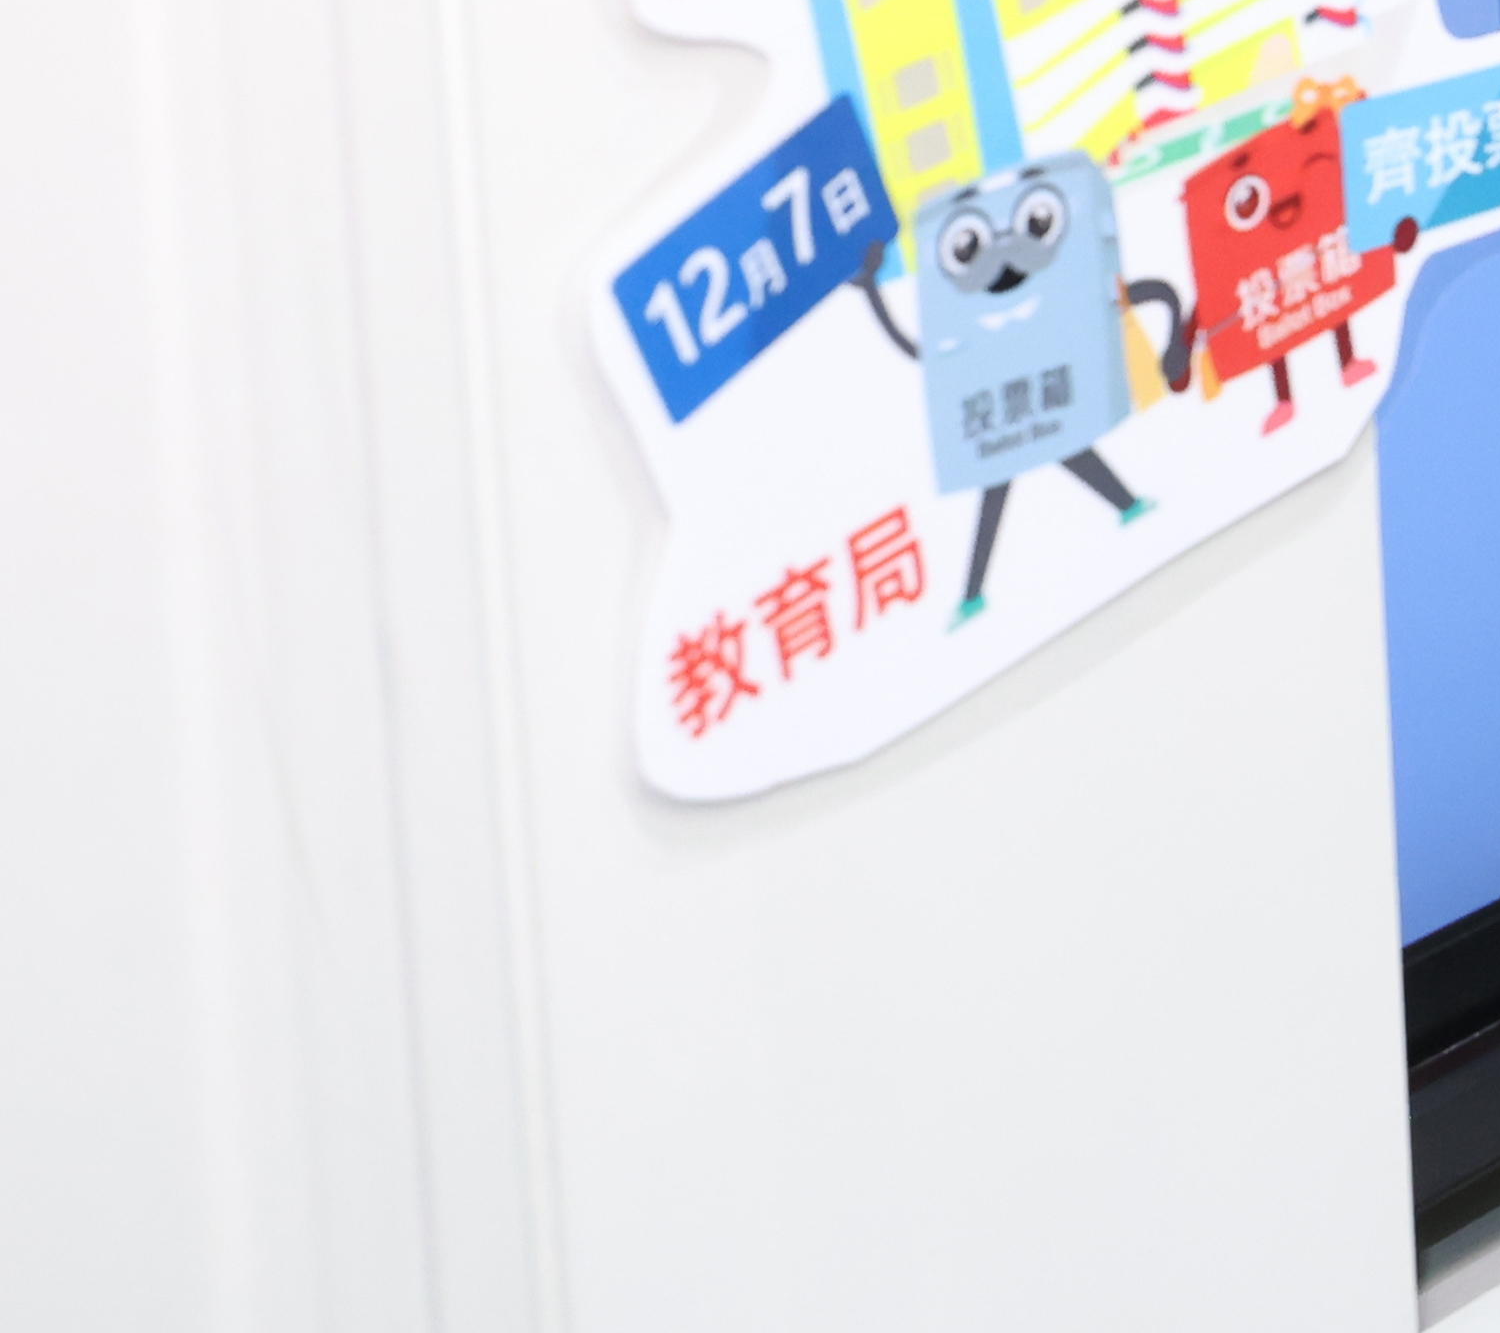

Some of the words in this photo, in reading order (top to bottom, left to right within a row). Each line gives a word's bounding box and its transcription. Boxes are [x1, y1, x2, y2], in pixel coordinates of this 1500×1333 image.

[644, 164, 872, 366] 12月7日
[665, 503, 929, 739] 教育局
